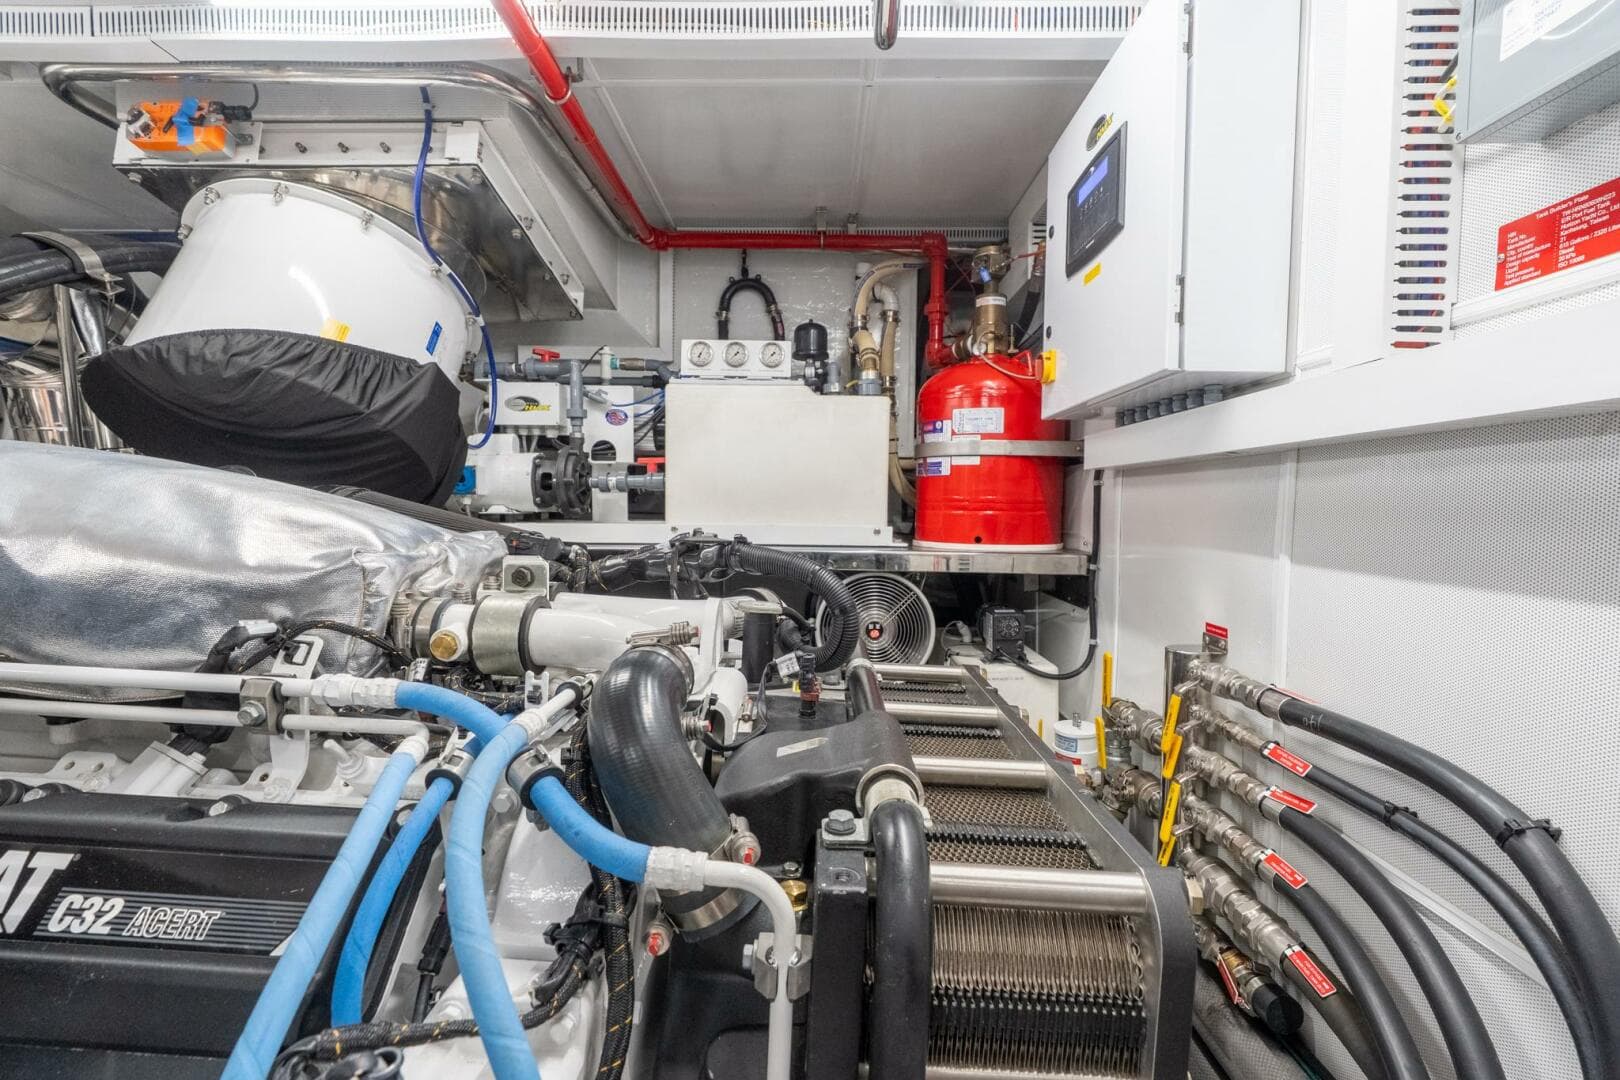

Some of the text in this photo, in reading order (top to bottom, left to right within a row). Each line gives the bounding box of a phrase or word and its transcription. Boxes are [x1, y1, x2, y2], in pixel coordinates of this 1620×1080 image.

[0, 849, 74, 934] AT
[47, 893, 221, 940] C32 ACERT
